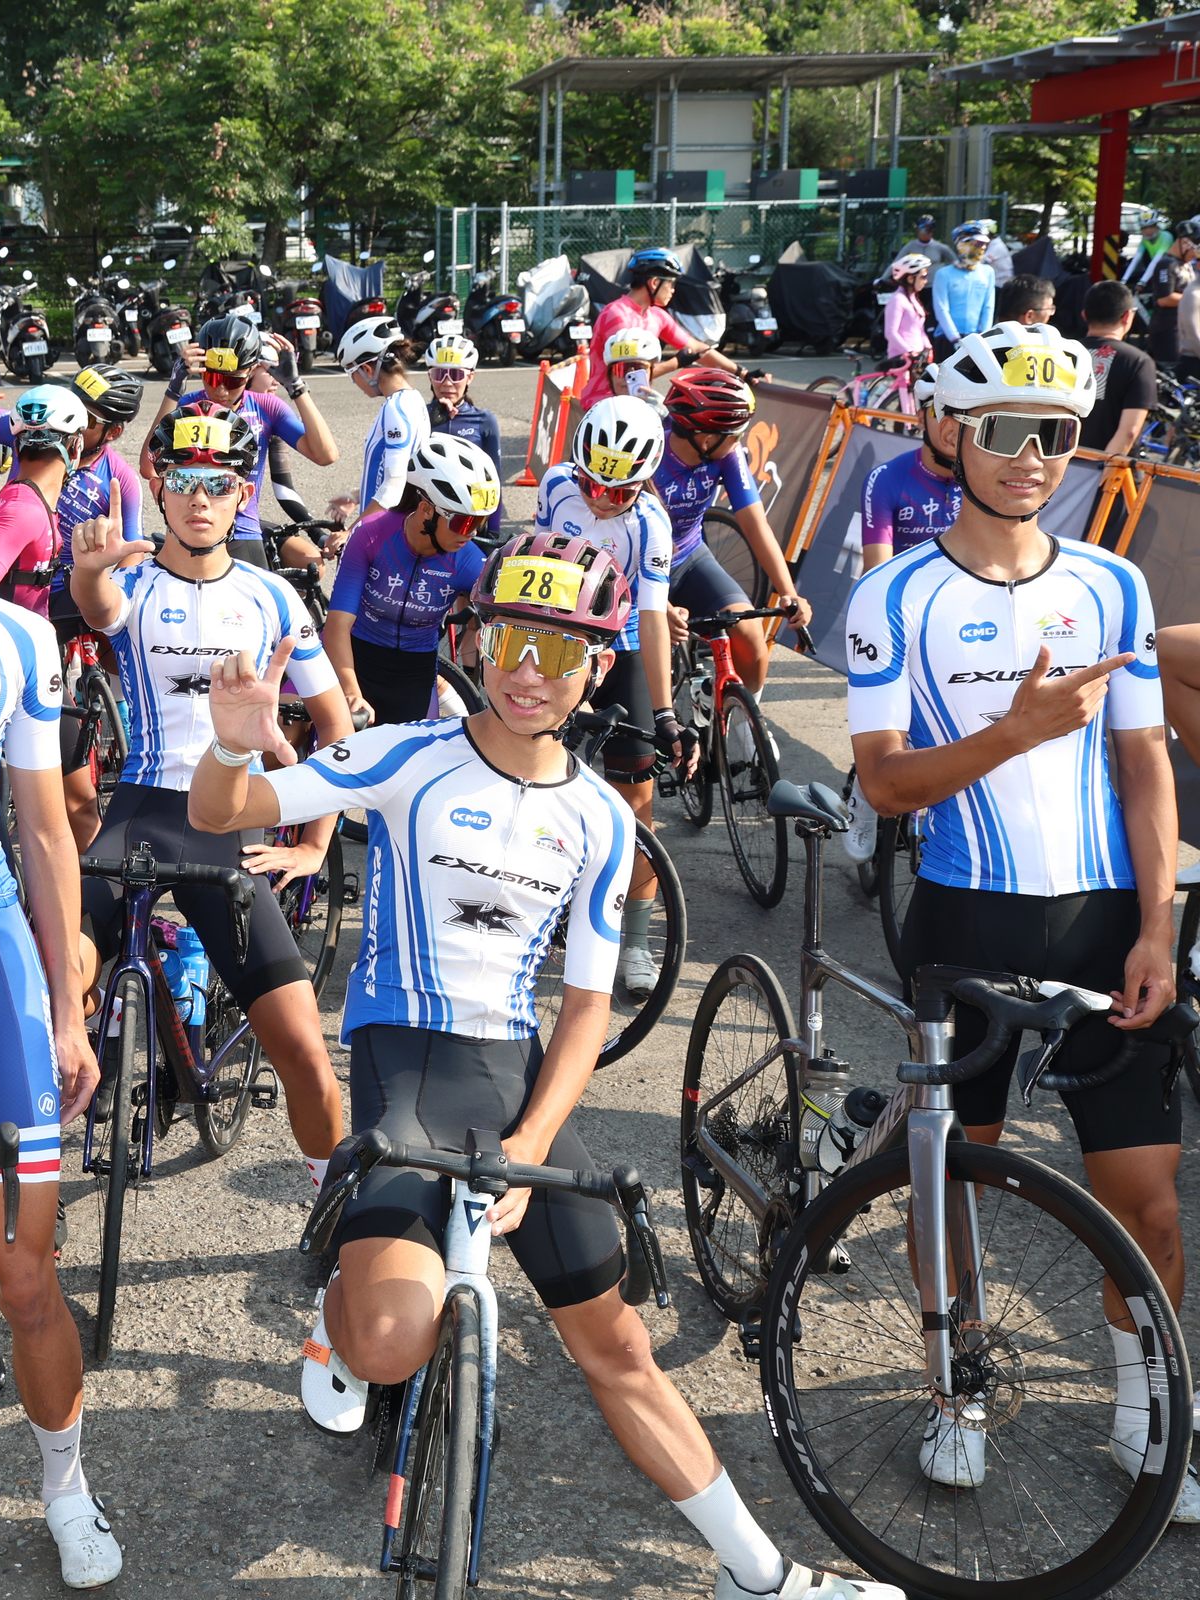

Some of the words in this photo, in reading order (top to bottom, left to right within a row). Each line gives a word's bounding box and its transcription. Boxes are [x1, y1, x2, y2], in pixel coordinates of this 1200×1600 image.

[619, 345, 629, 356] 18
[217, 354, 224, 368] 9
[1026, 356, 1055, 384] 30
[191, 425, 212, 444] 31
[599, 457, 618, 475] 37
[484, 489, 497, 510] 13
[866, 464, 888, 529] MERIDA
[422, 568, 453, 579] VERGE
[519, 569, 554, 600] 28
[162, 612, 186, 620] KMC
[961, 627, 996, 637] KMC
[150, 645, 244, 656] EXUSTA
[848, 633, 878, 662] 720
[453, 812, 491, 827] KMC
[427, 853, 562, 896] EXUSTAR
[364, 845, 383, 998] EXUSTAR
[776, 1245, 829, 1494] FULCRUM
[764, 1394, 779, 1438] KENDA
